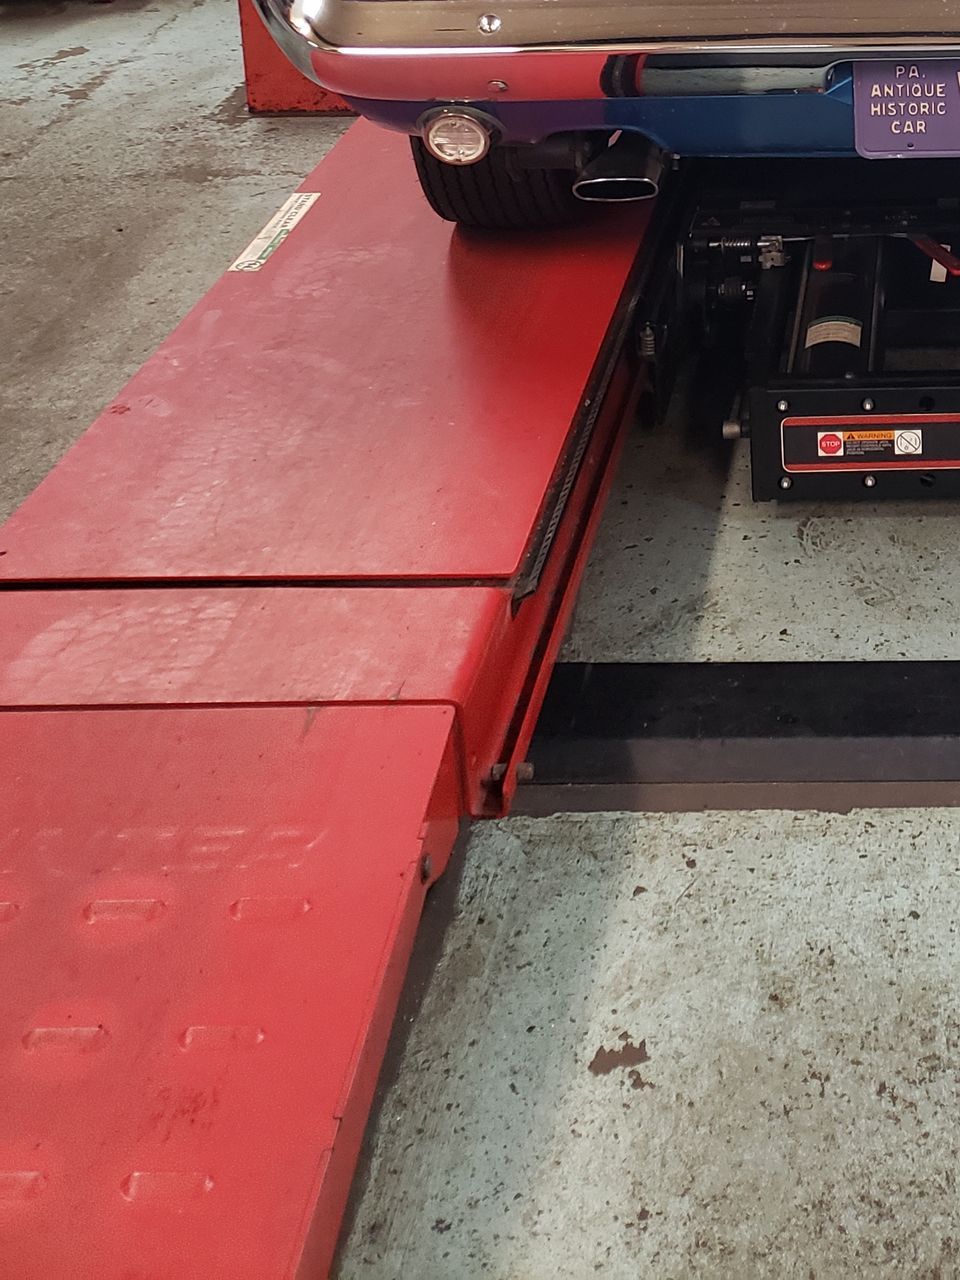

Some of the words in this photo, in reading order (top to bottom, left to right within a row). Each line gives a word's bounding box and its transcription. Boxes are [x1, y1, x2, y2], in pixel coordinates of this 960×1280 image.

[895, 66, 926, 79] PA.
[870, 83, 946, 98] ANTIQUE
[870, 102, 946, 116] HISTORIC
[891, 120, 927, 134] CAR
[821, 441, 840, 449] STOP
